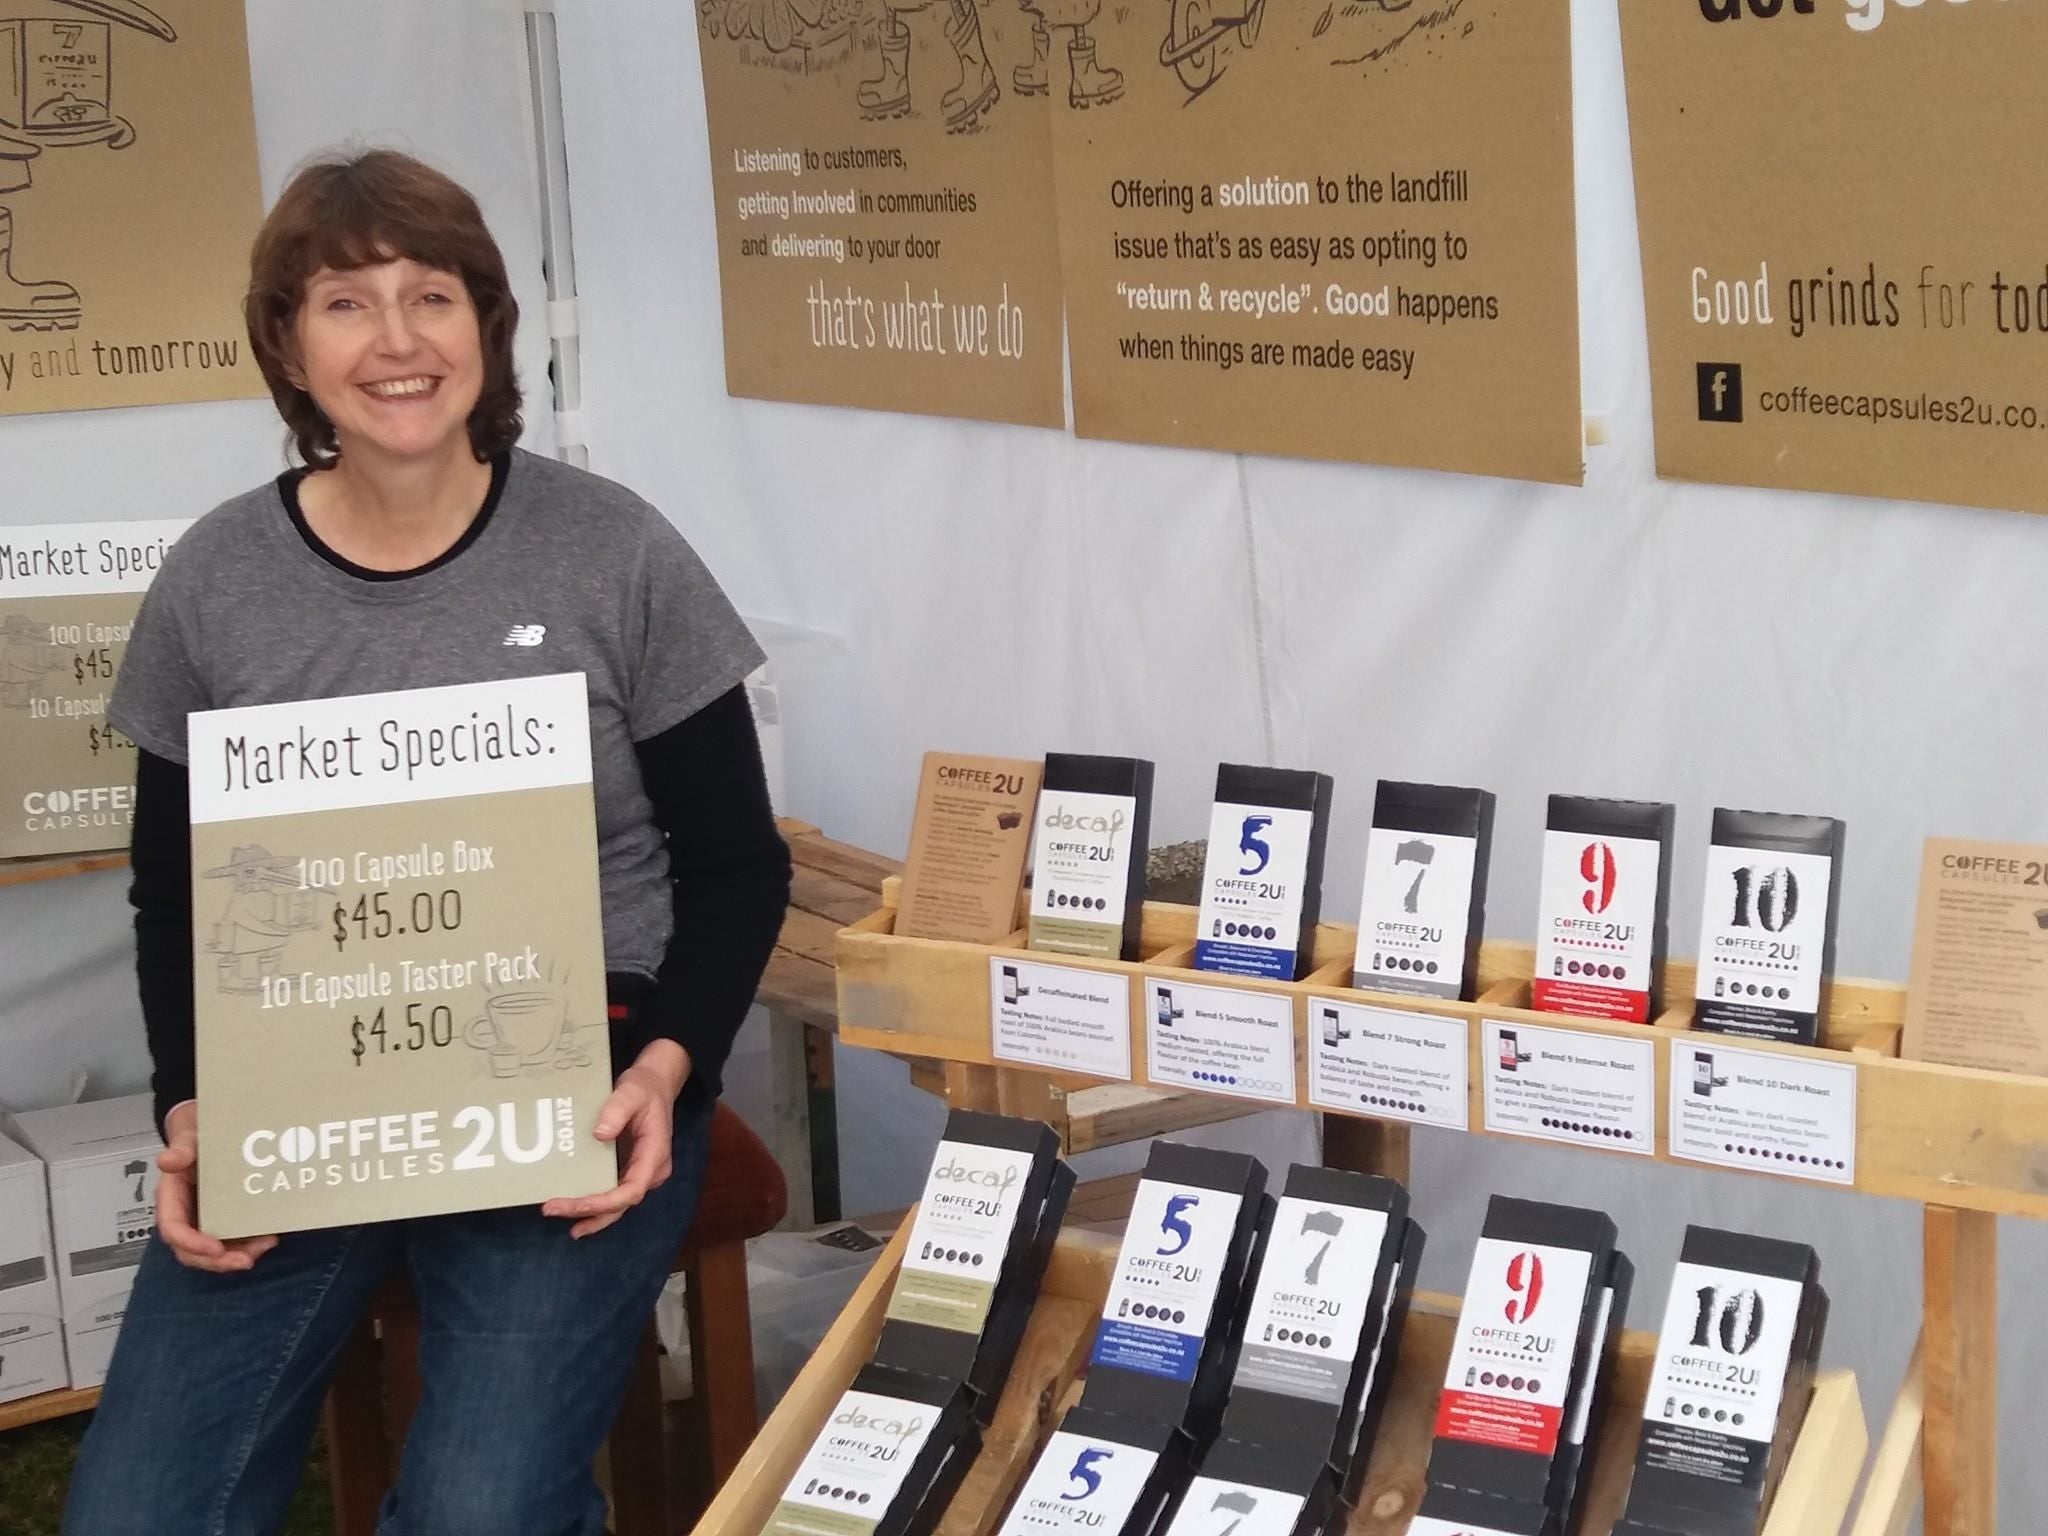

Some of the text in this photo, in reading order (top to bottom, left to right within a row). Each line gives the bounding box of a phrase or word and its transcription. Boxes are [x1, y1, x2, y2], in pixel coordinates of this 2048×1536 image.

[734, 145, 908, 176] Listening to customers,
[737, 187, 977, 221] getting Involved in communities
[1110, 169, 1469, 214] Offering a solution to the landfill
[741, 233, 942, 264] and delivering to your door
[1113, 227, 1469, 268] issue that's as easy as opting to
[806, 277, 1025, 360] that's what we do
[1198, 281, 1214, 311] &
[1326, 283, 1390, 317] Good
[1397, 285, 1500, 327] happens
[1691, 260, 1775, 326] Good
[1788, 261, 1901, 339] grinds
[1916, 264, 1975, 329] for
[29, 337, 83, 379] and
[91, 339, 238, 377] tomorrow
[1118, 331, 1416, 381] when things are made easy
[0, 538, 174, 581] Market Speci
[49, 619, 134, 647] 100 Capsu
[73, 648, 114, 686] $45
[29, 692, 112, 720] 10 Capsul
[88, 722, 137, 757] $4.
[223, 704, 557, 793] Market Specials:
[23, 785, 138, 816] COFFE
[937, 765, 1025, 796] COFFEE 2U
[1044, 803, 1126, 851] decaf
[1239, 814, 1273, 876] 5
[296, 840, 495, 891] 100 Capsule Box
[1088, 845, 1111, 862] 2U
[1941, 854, 2022, 875] COFFEE
[1257, 882, 1283, 900] 2U
[1394, 838, 1436, 915] 7
[1580, 840, 1617, 916] 9
[332, 888, 463, 953] $45.00
[1730, 865, 1800, 934] 10
[1419, 926, 1443, 943] 2U
[1603, 922, 1631, 942] 2U
[1767, 941, 1797, 962] 2U
[260, 945, 542, 1010] 10 Capsule Taster Pack
[350, 1002, 453, 1067] $4.50
[1736, 1074, 1765, 1087] Blend
[1780, 1081, 1803, 1094] Dark
[1804, 1085, 1831, 1098] Roast
[241, 1110, 442, 1169] COFFEE
[451, 1098, 555, 1172] 2U
[124, 1158, 148, 1203] 7
[242, 1151, 445, 1196] CAPSULES
[933, 1155, 1020, 1205] decaf
[974, 1199, 999, 1218] 2U
[1155, 1194, 1201, 1257] 5
[1300, 1210, 1345, 1286] 7
[1172, 1264, 1199, 1283] 2U
[1501, 1251, 1545, 1325] 9
[1316, 1299, 1342, 1318] 2U
[1688, 1283, 1766, 1357] 10
[1522, 1334, 1551, 1354] 2U
[1725, 1364, 1756, 1386] 2U
[833, 1405, 924, 1450] decaf
[1059, 1447, 1115, 1501] 5
